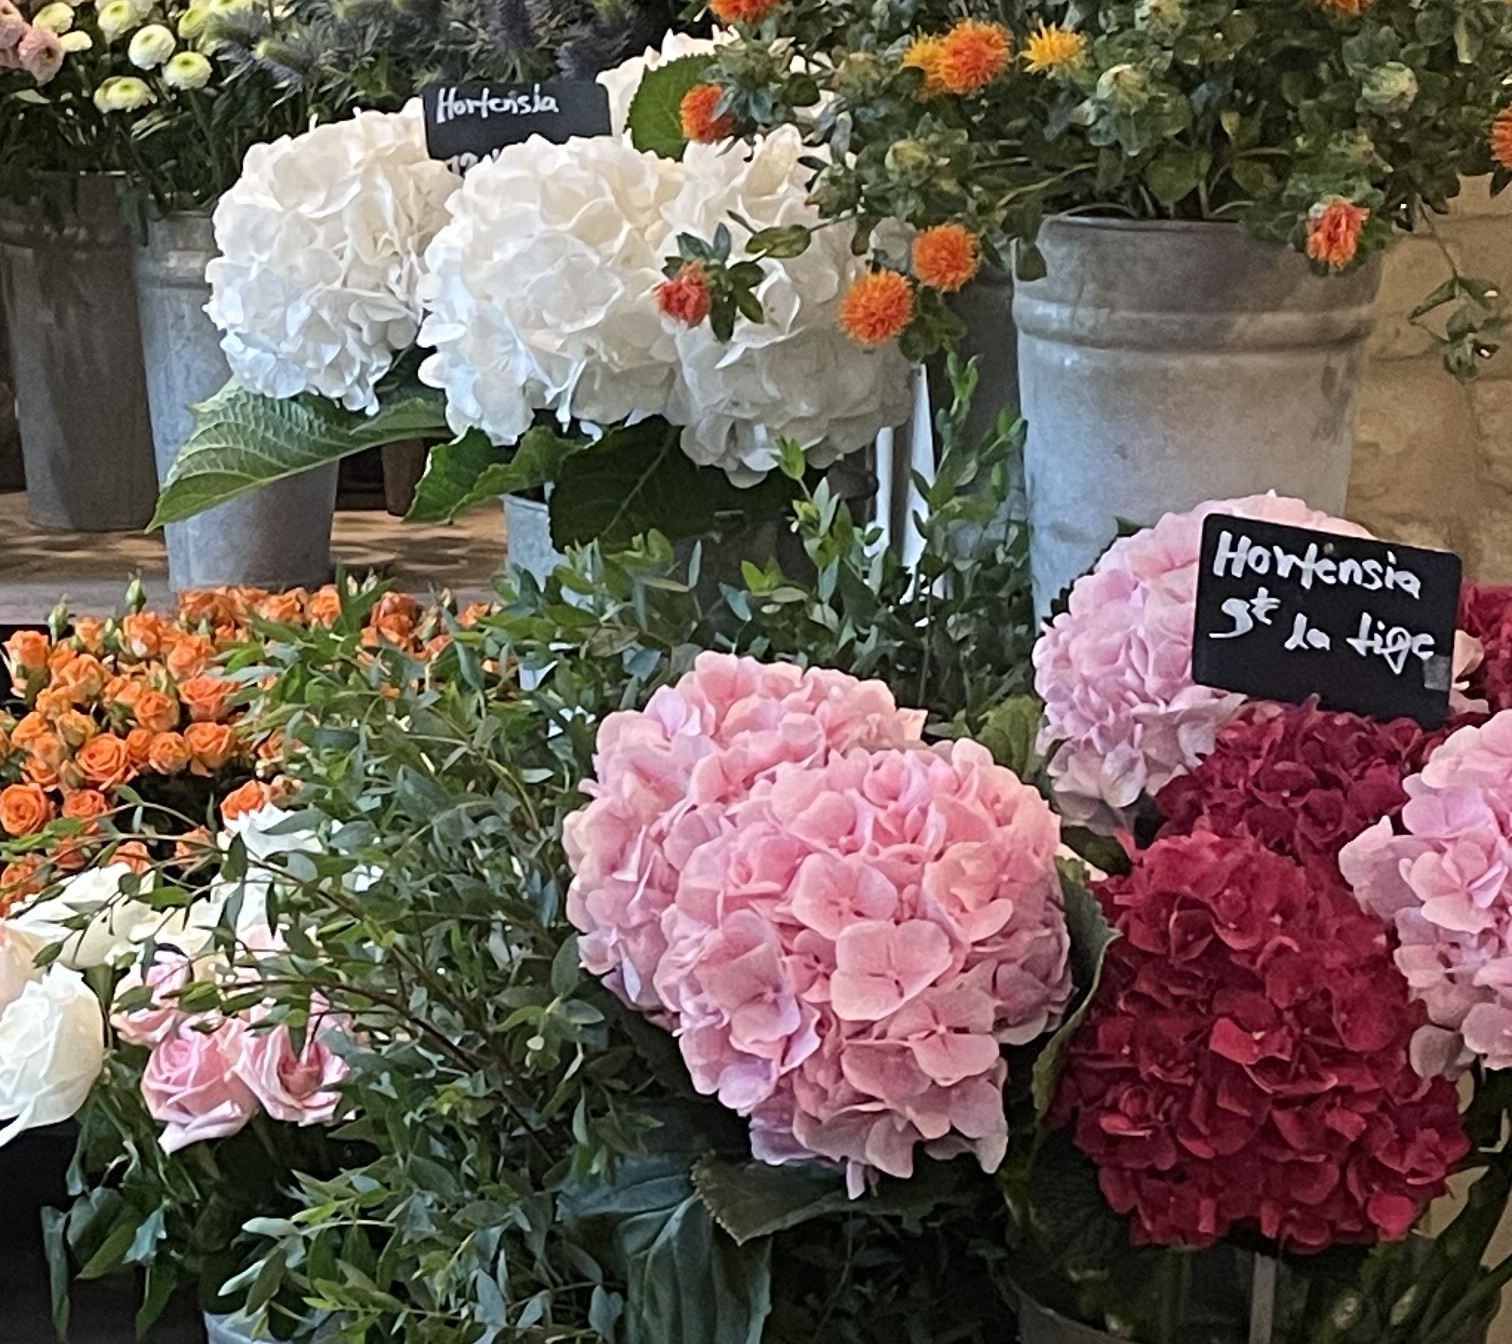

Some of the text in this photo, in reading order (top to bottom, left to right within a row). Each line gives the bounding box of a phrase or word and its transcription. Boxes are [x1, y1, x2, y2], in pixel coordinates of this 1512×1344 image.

[436, 83, 560, 124] Hortensia
[1213, 531, 1421, 600] Hortensia
[1284, 613, 1331, 651] la
[1346, 612, 1435, 675] tige
